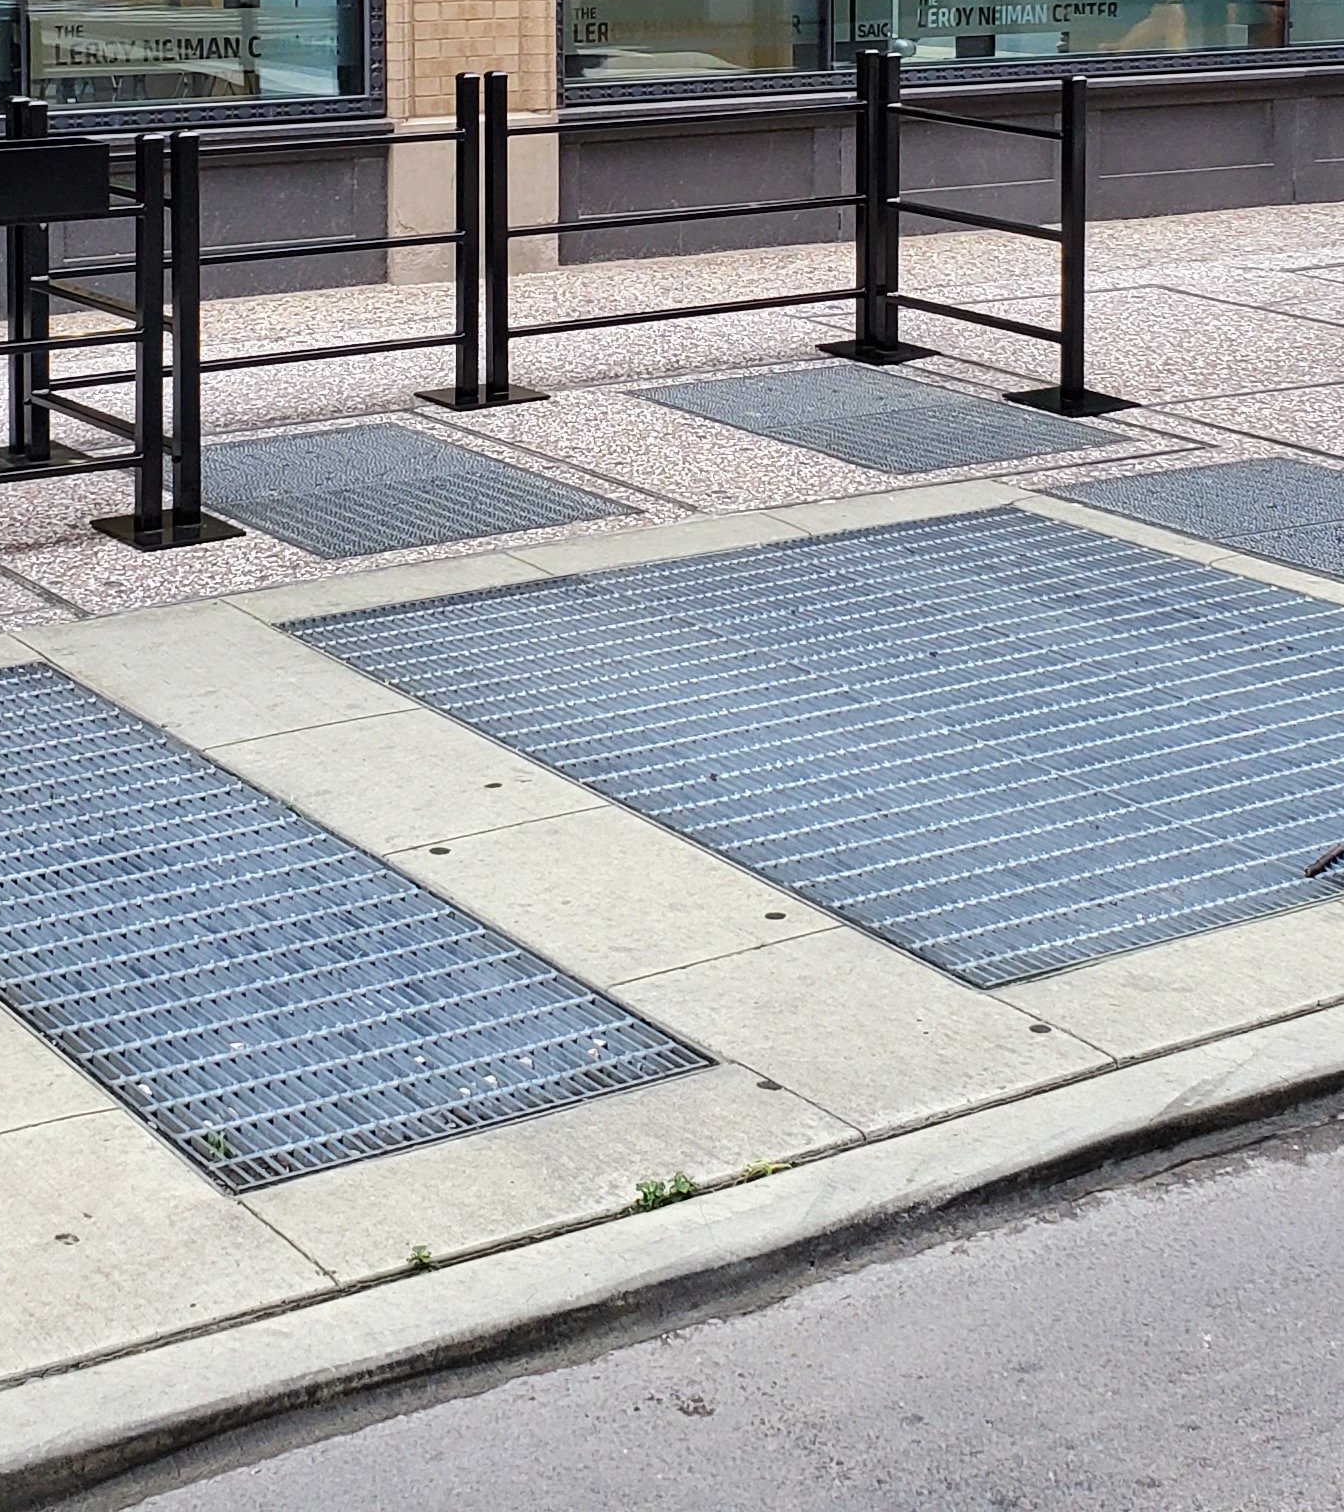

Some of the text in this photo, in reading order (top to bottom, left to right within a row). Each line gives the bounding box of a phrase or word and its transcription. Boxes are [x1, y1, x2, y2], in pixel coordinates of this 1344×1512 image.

[573, 7, 597, 20] THE
[917, 6, 973, 28] LEROY
[978, 3, 1047, 26] NEIMAN
[55, 25, 84, 38] THE
[858, 24, 892, 38] SAIC
[55, 41, 135, 67] LEROY
[144, 37, 241, 62] NEIMAN
